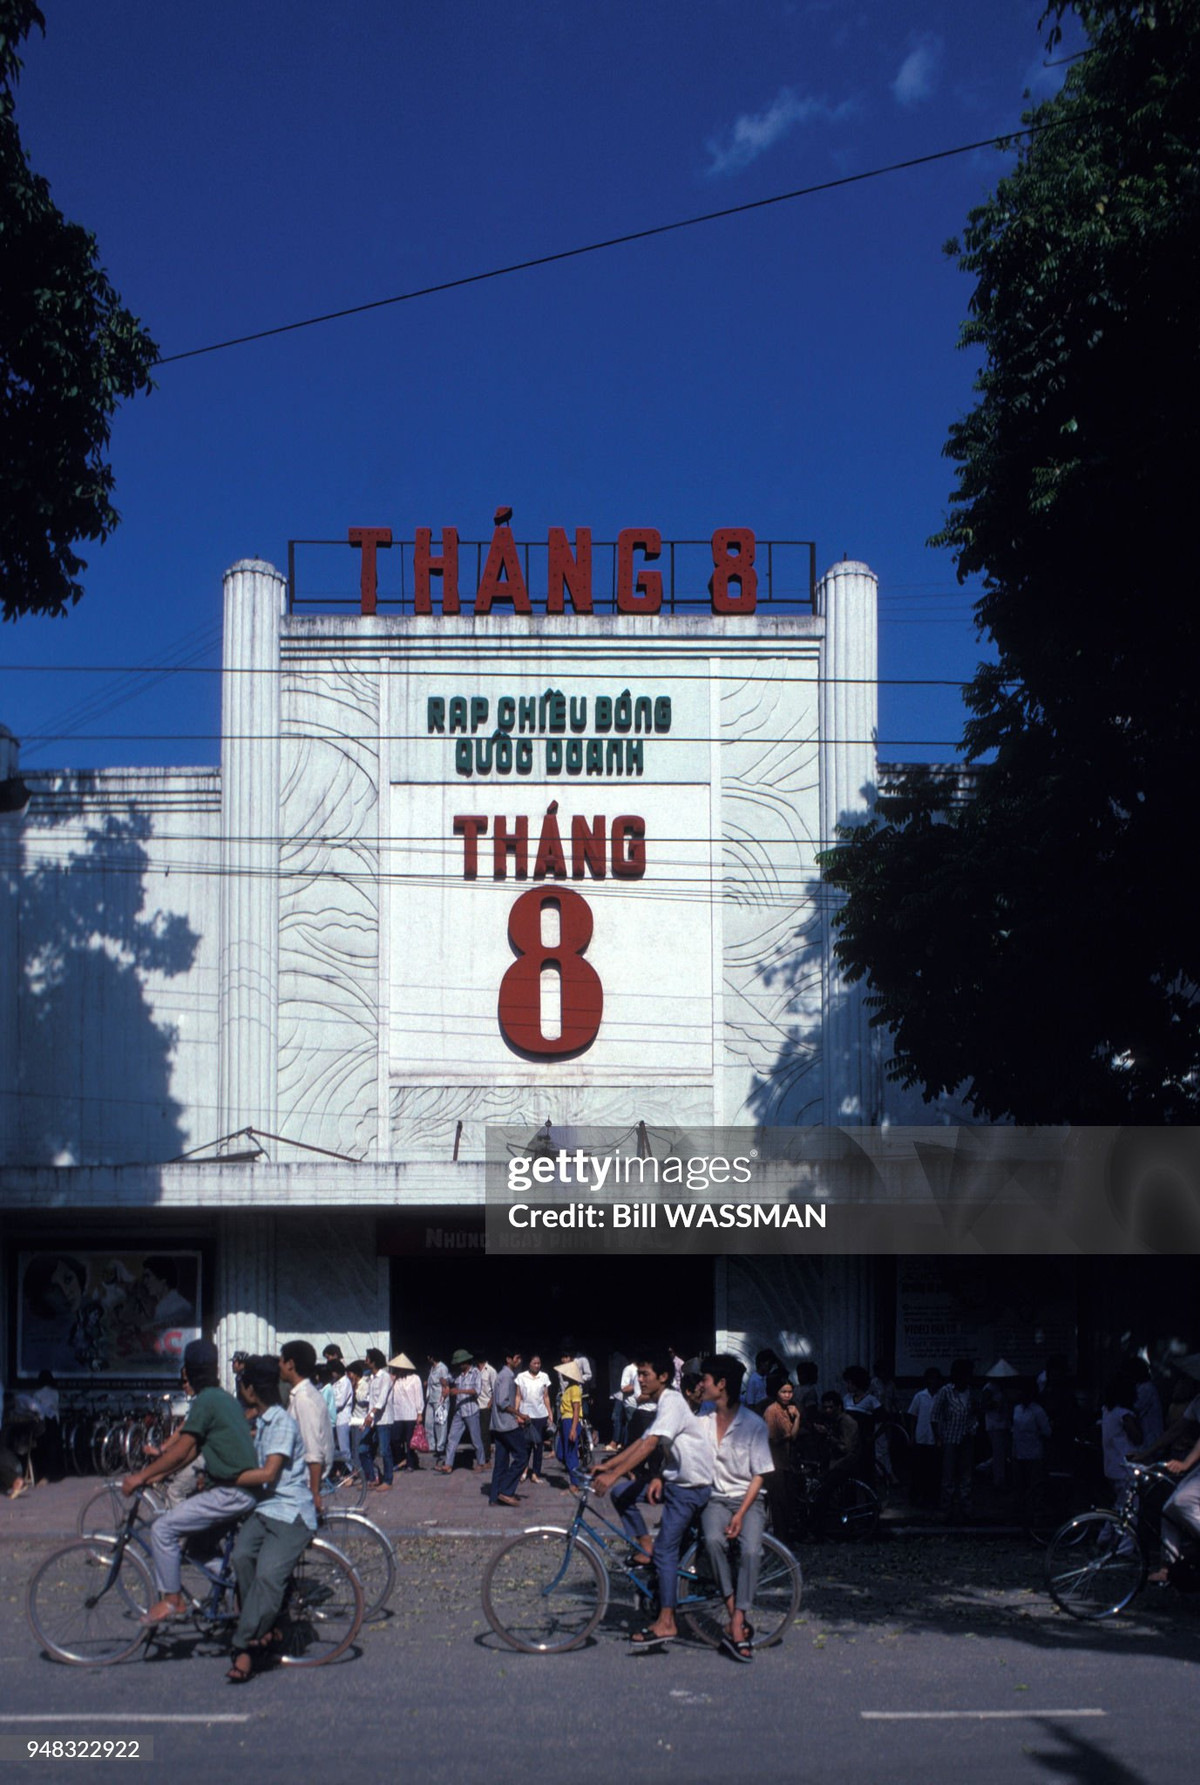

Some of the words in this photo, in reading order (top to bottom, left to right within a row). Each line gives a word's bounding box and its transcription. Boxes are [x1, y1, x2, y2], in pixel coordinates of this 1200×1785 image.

[348, 506, 662, 615] THÁNG
[711, 527, 757, 615] 8
[498, 688, 587, 734] CHIẾU
[595, 688, 671, 734] BÓNG
[455, 728, 533, 778] QUỐC
[546, 738, 643, 777] DOANH
[453, 799, 646, 881] THÁNG
[498, 884, 603, 1056] 8
